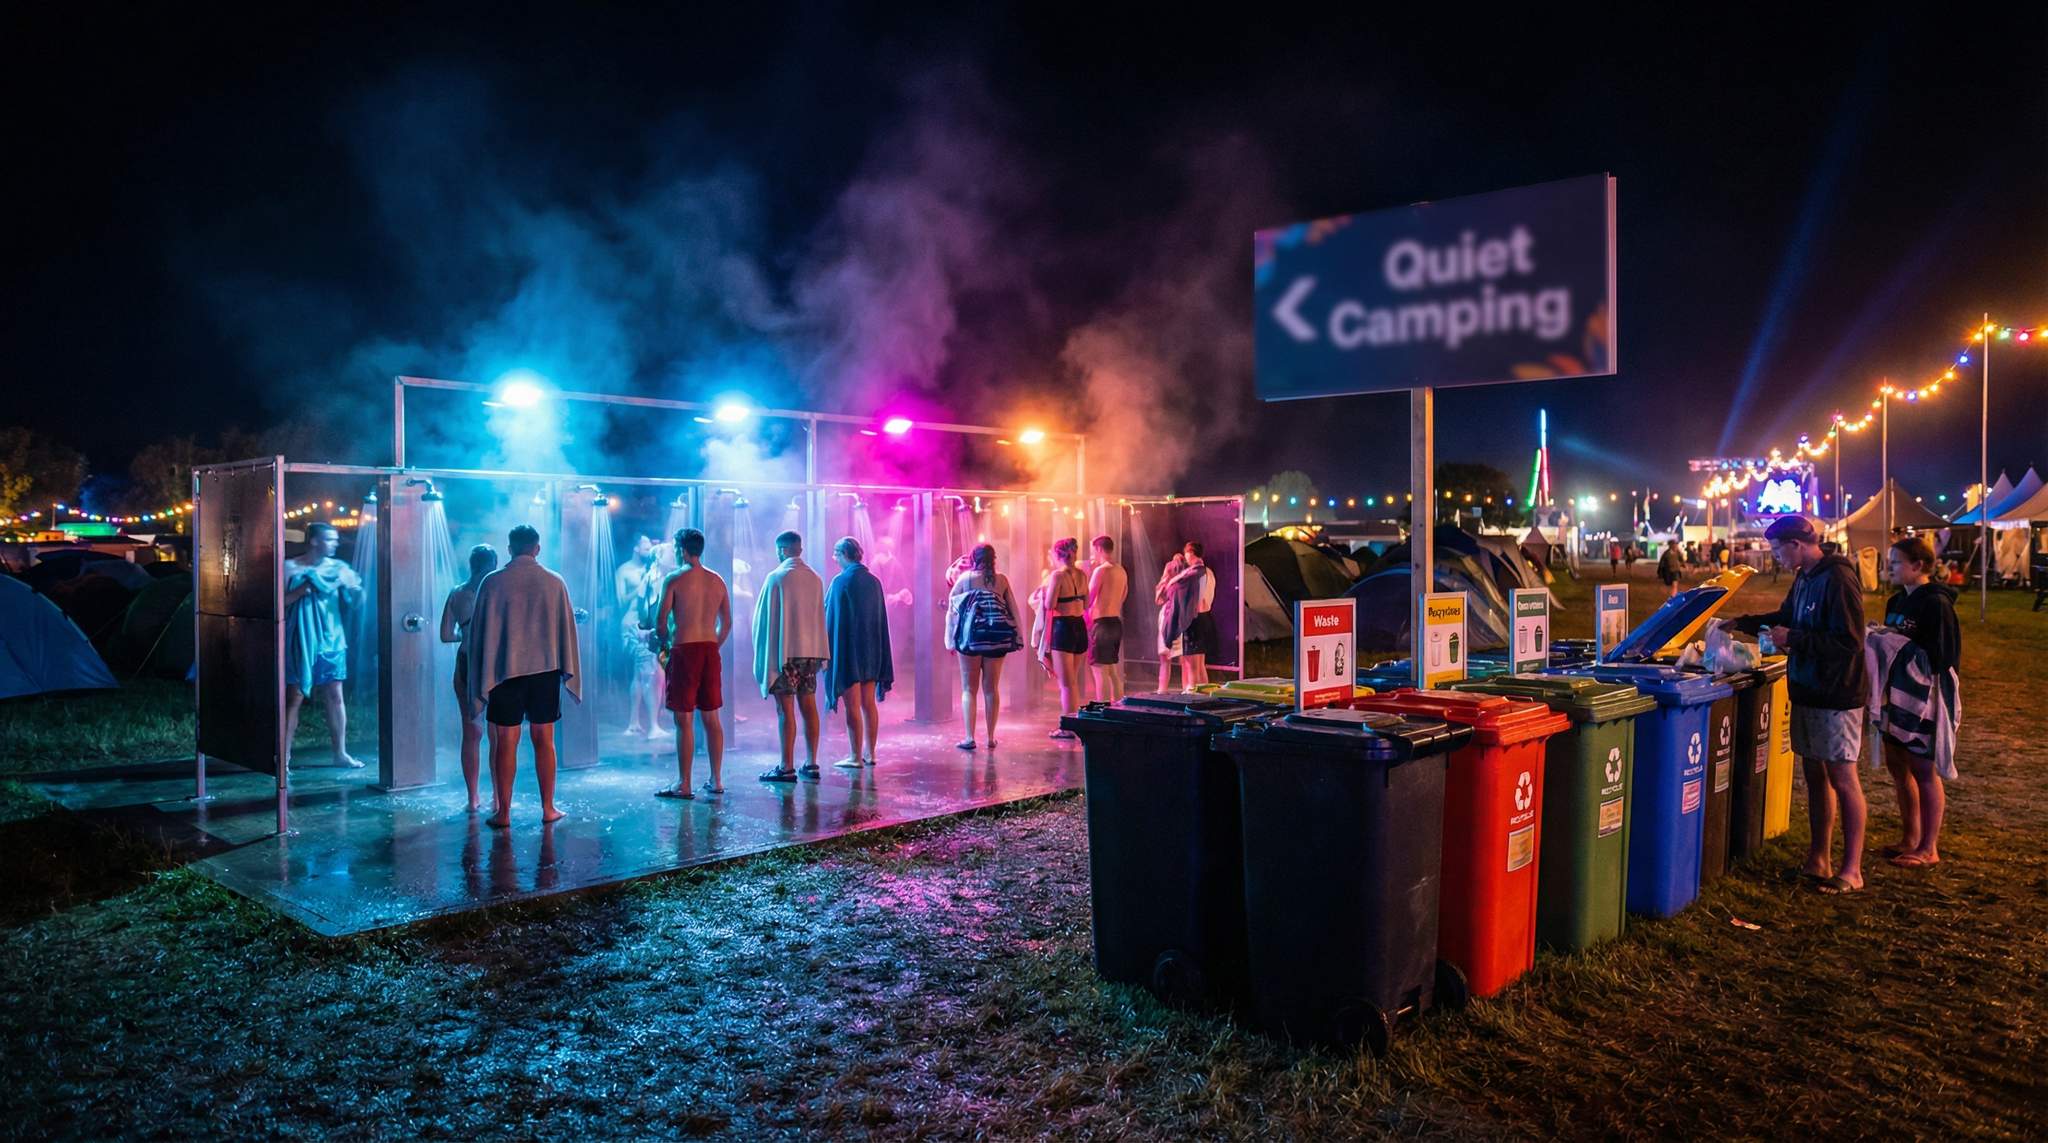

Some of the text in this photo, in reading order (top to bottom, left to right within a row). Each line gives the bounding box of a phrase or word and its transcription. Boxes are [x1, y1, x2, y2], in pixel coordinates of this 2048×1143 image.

[1385, 226, 1534, 290] Quiet
[1329, 284, 1570, 349] Camping
[1313, 615, 1340, 628] Waste
